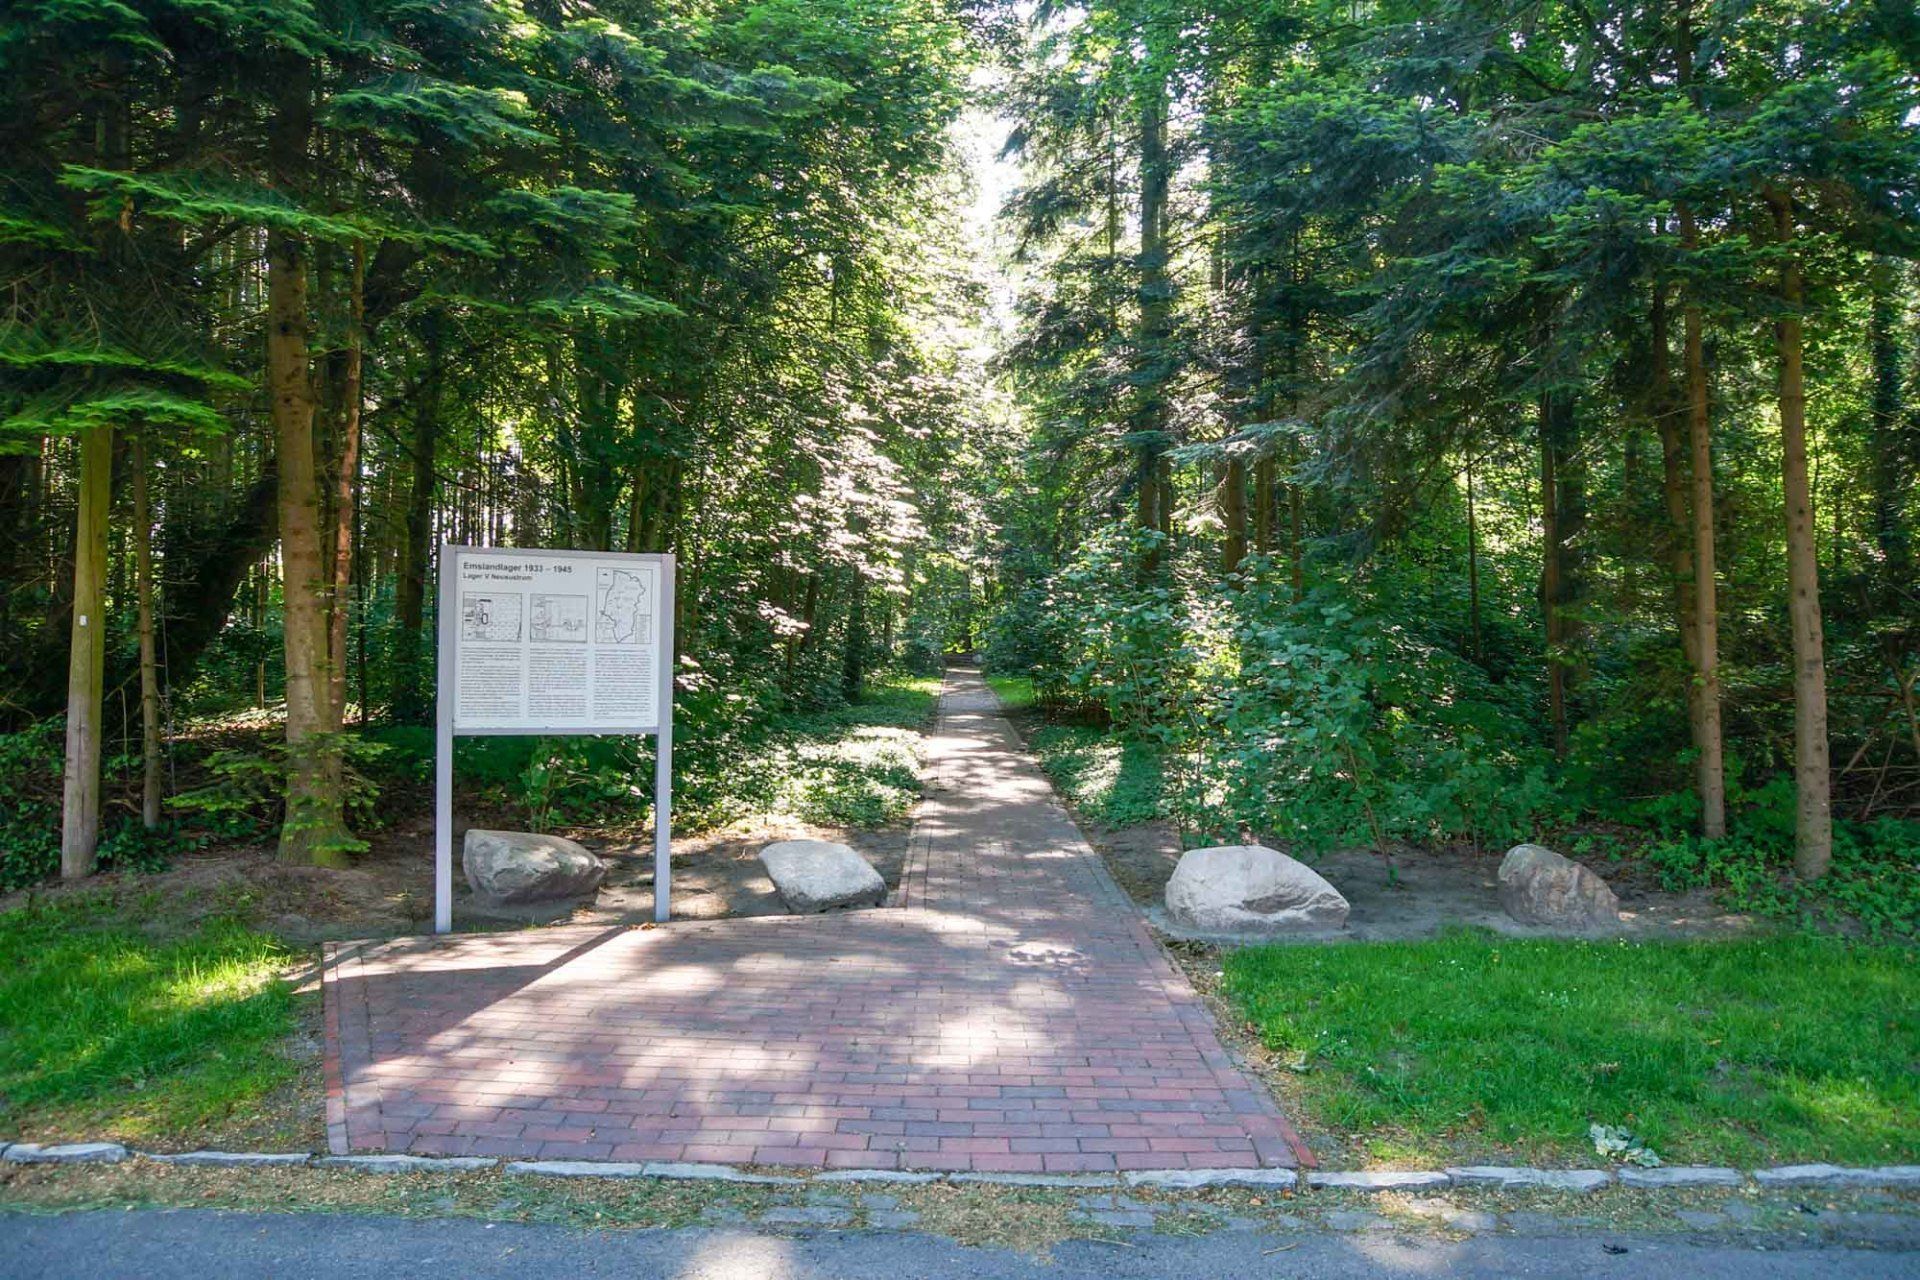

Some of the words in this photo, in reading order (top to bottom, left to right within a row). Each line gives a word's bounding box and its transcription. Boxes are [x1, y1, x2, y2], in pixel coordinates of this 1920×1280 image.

[463, 562, 522, 573] Emslandlager
[524, 564, 543, 573] 1933
[553, 565, 573, 574] 1945
[463, 572, 482, 580] Lager
